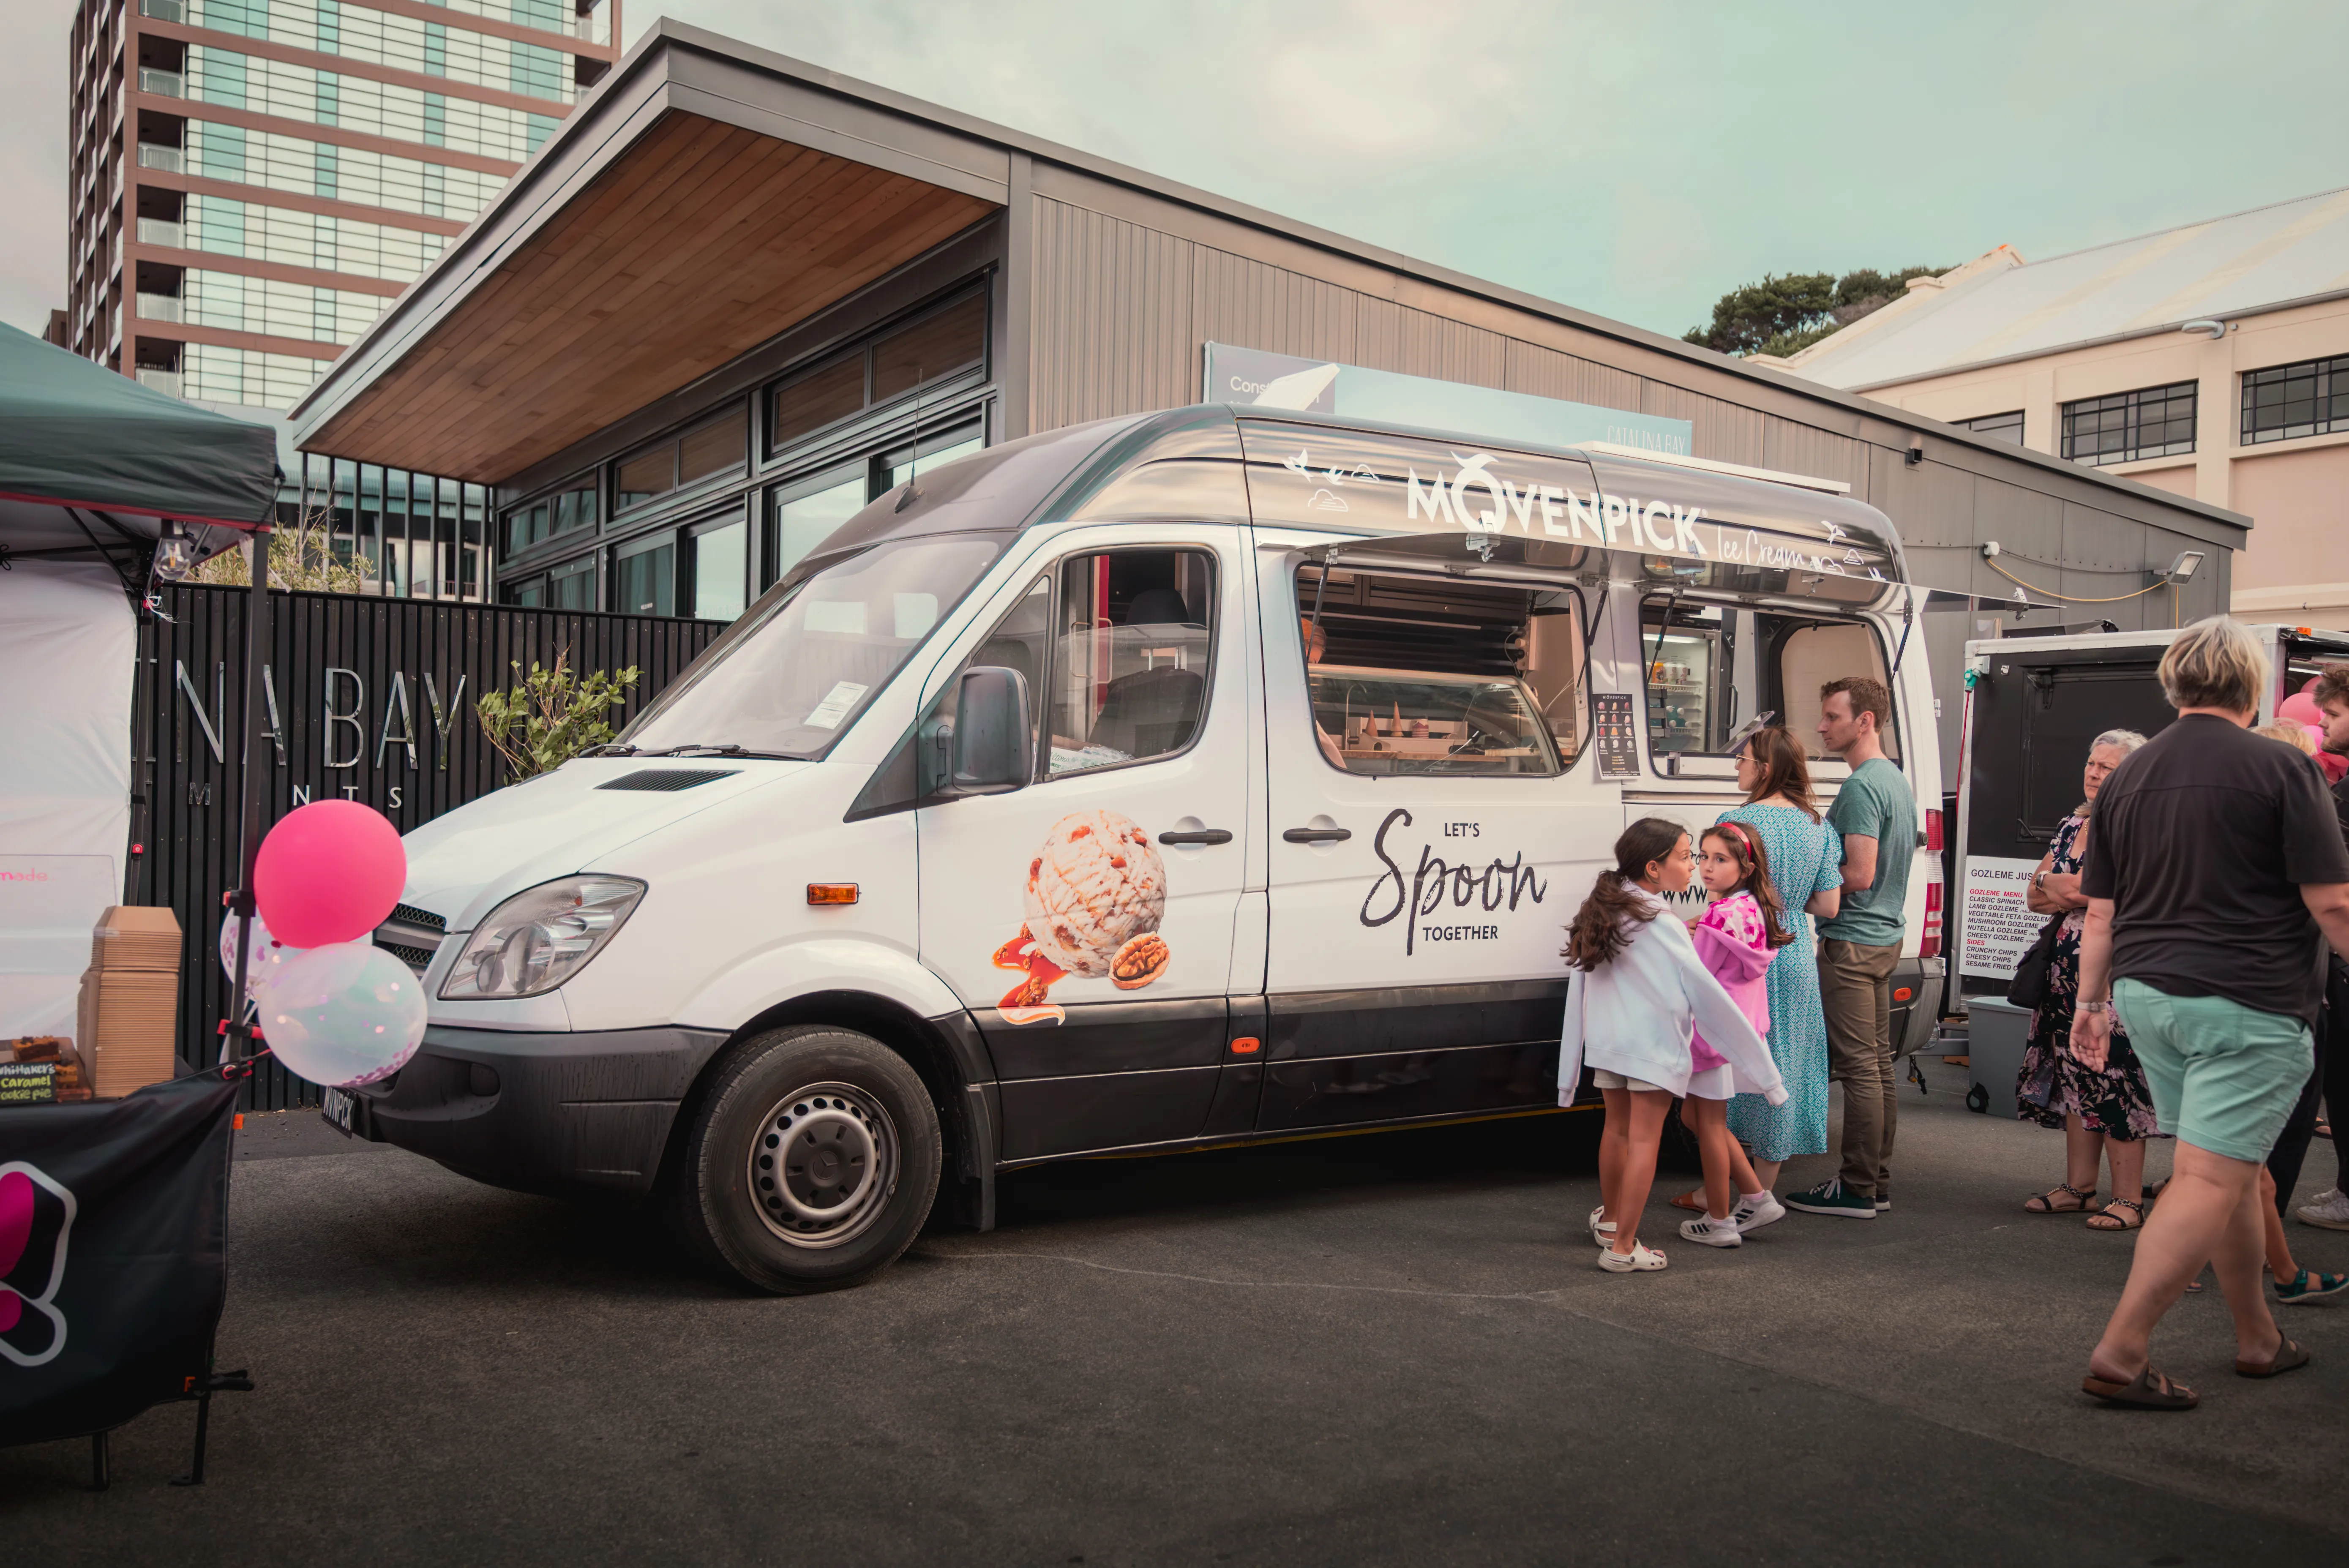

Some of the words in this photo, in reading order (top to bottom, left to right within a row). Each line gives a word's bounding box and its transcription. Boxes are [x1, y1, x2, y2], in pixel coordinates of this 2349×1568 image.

[1607, 425, 1661, 452] CATALINA
[1665, 434, 1685, 455] BAY
[1718, 525, 1742, 561] Ice
[1746, 529, 1805, 567] Cream
[324, 668, 467, 770] BAY
[1444, 822, 1480, 837] LET'S
[1971, 869, 2013, 879] GOZLEME
[1360, 808, 1547, 957] Spoon
[1968, 910, 2004, 918] VEGETABLE
[1968, 918, 2006, 926] MUSHROOM
[2008, 921, 2039, 929] GOZLEME
[1422, 925, 1498, 941] TOGETHER
[1993, 934, 2024, 942] GOZLEME
[1997, 927, 2028, 935] GOZLEME
[1966, 946, 1997, 954] CRUNCHY
[0, 1089, 31, 1100] ookie
[32, 1088, 52, 1101] pie
[323, 1086, 354, 1131] MVNPCK
